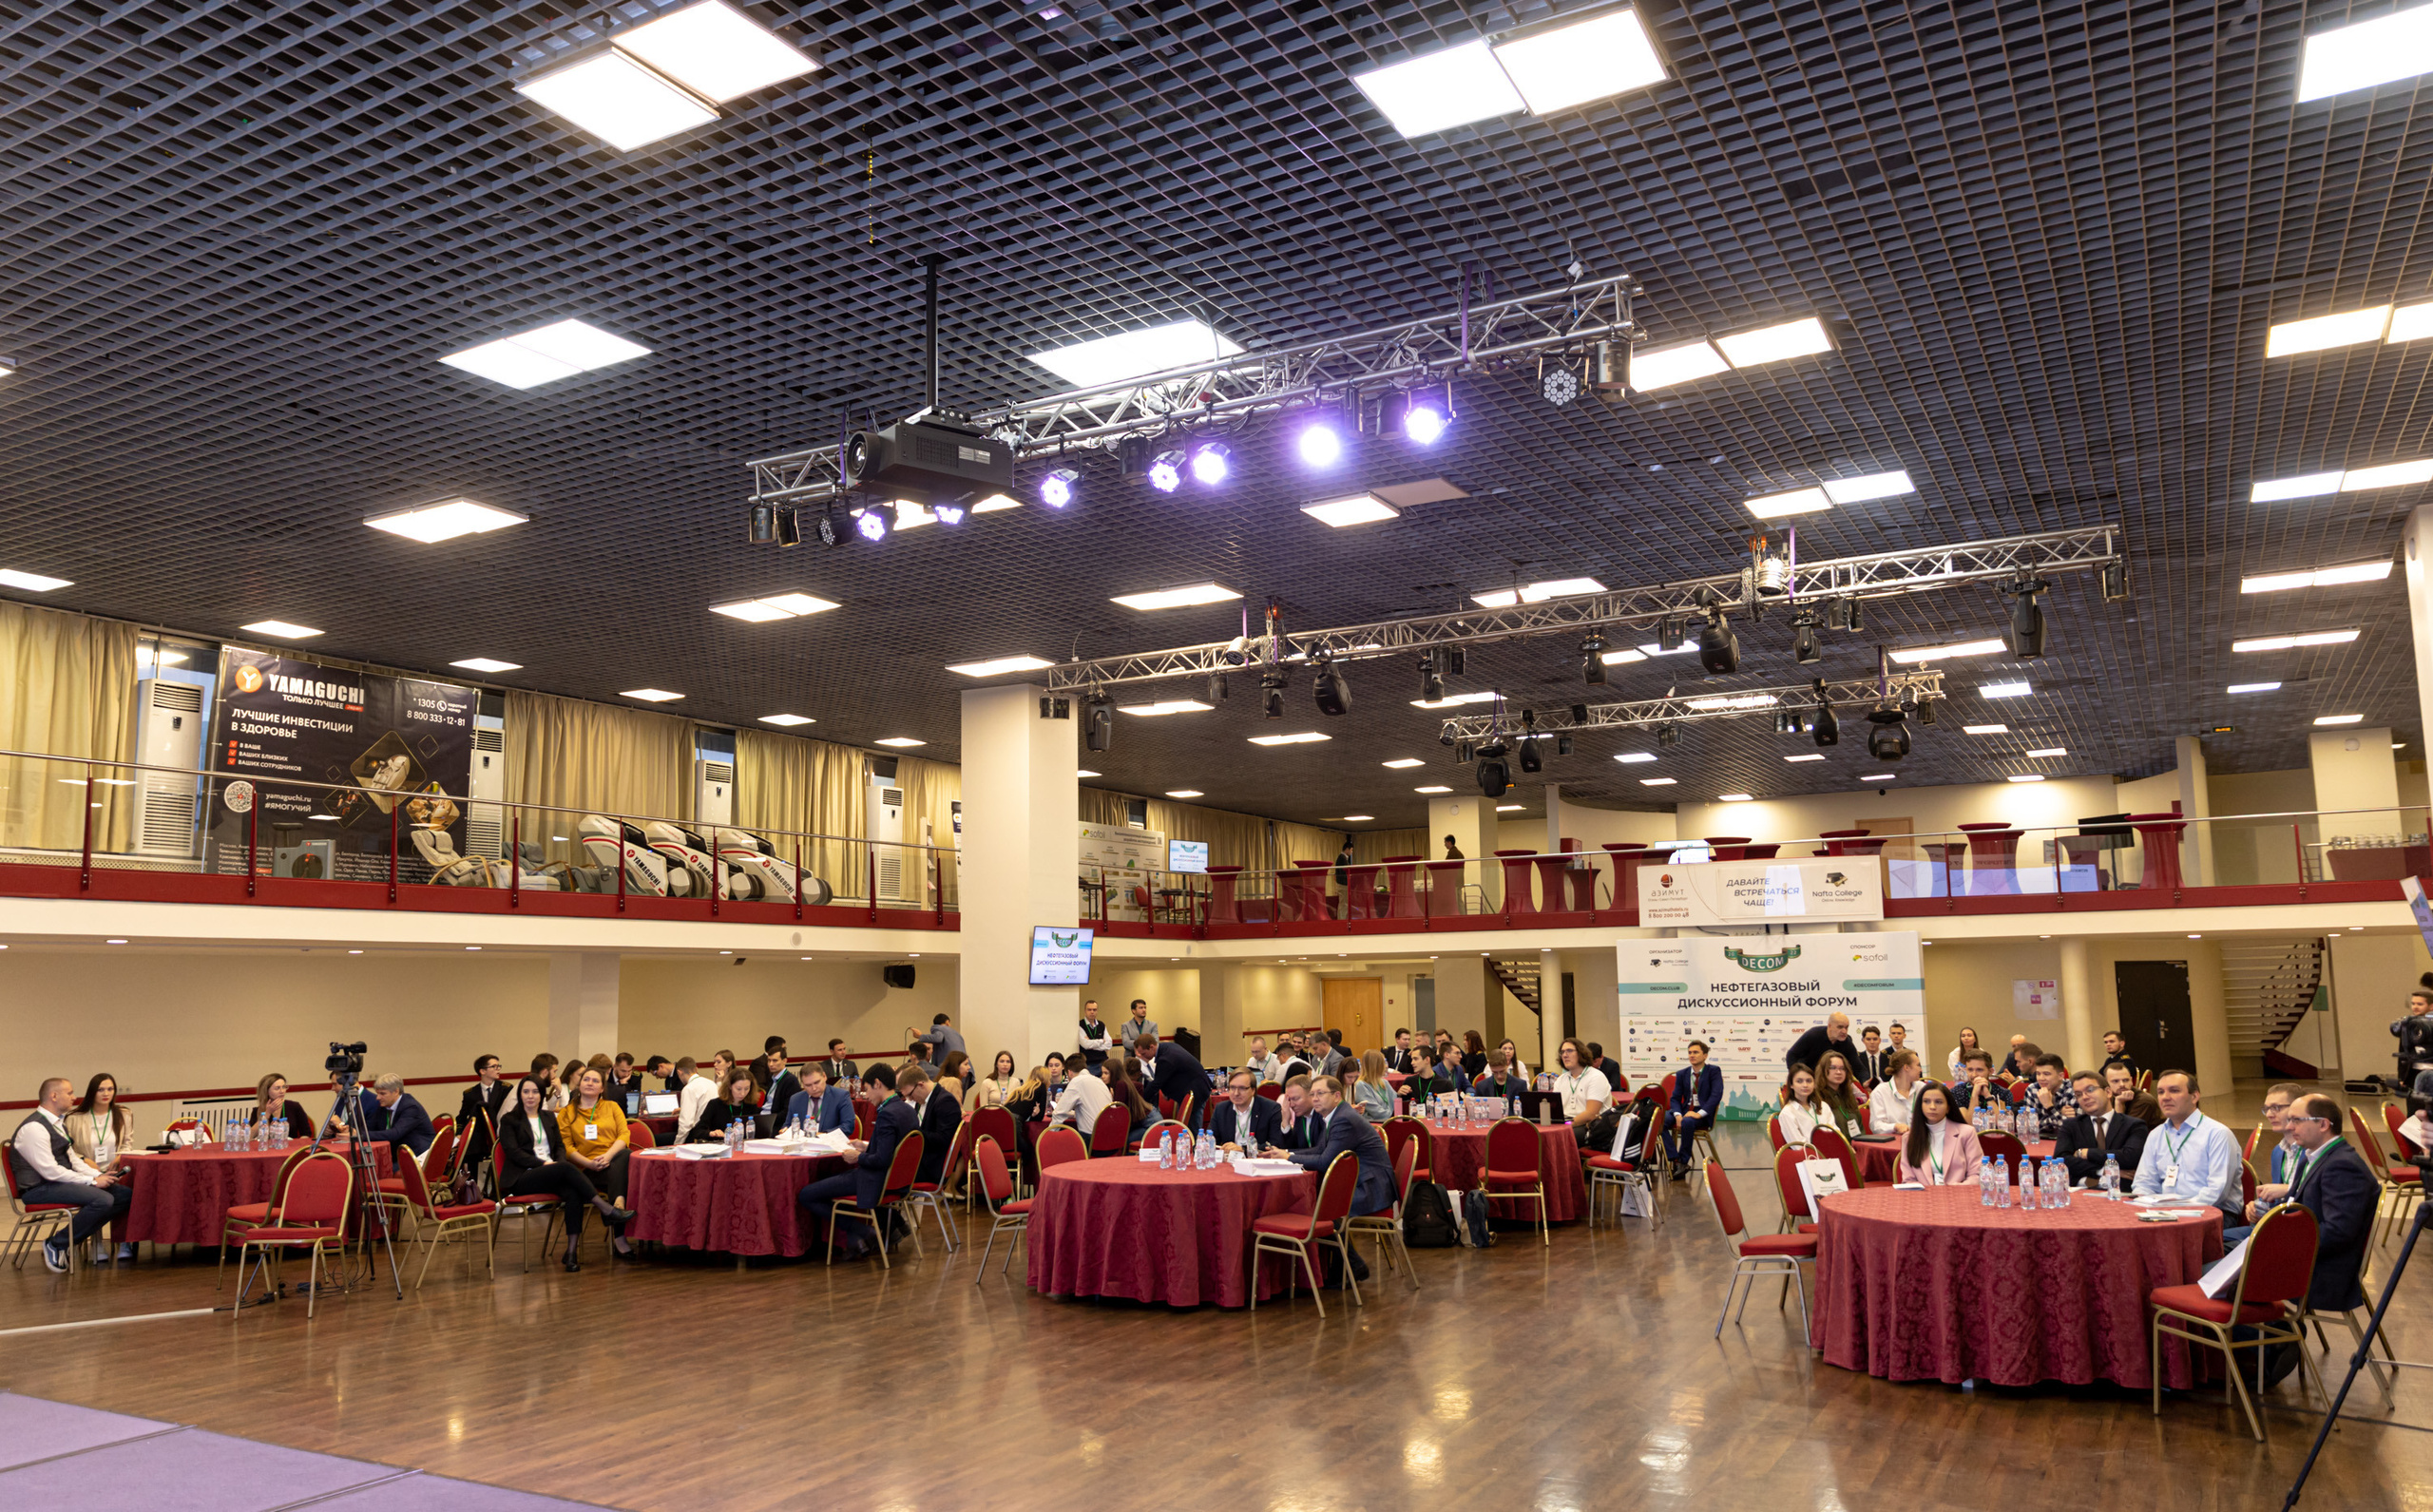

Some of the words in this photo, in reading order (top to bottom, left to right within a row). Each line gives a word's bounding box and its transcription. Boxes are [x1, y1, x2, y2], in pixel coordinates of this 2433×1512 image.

[269, 673, 364, 704] YAMAGUCHI
[282, 694, 314, 705] ТОЛЬКО
[314, 699, 344, 710] ЛУЧШЕЕ
[418, 698, 435, 709] 1305
[232, 708, 280, 723] ЛУЧШИЕ
[281, 715, 354, 733] ИНВЕСТИЦИИ
[407, 710, 412, 718] 8
[413, 711, 429, 720] 800
[231, 722, 239, 731] В
[240, 722, 297, 738] ЗДОРОВЬЕ
[260, 761, 302, 772] СОТРУДНИКОВ
[265, 793, 312, 803] yamaguchi.ru
[264, 802, 312, 813] #ЯМОГУЧИЙ
[633, 856, 661, 886] YAMAGUCHI
[769, 866, 795, 893] YAMAGUCHI
[1726, 877, 1770, 888] ДАВАЙТЕ
[1734, 887, 1800, 897] ВСТРЕЧАТЬСЯ
[1743, 898, 1774, 907] ЧАЩЕ!
[1741, 956, 1785, 969] DECOM
[1863, 953, 1888, 962] sofoil
[1711, 980, 1820, 992] НЕФТЕГАЗОВЫЙ
[1677, 995, 1802, 1009] ДИСКУССИОННЫЙ
[1806, 997, 1858, 1007] ФОРУМ
